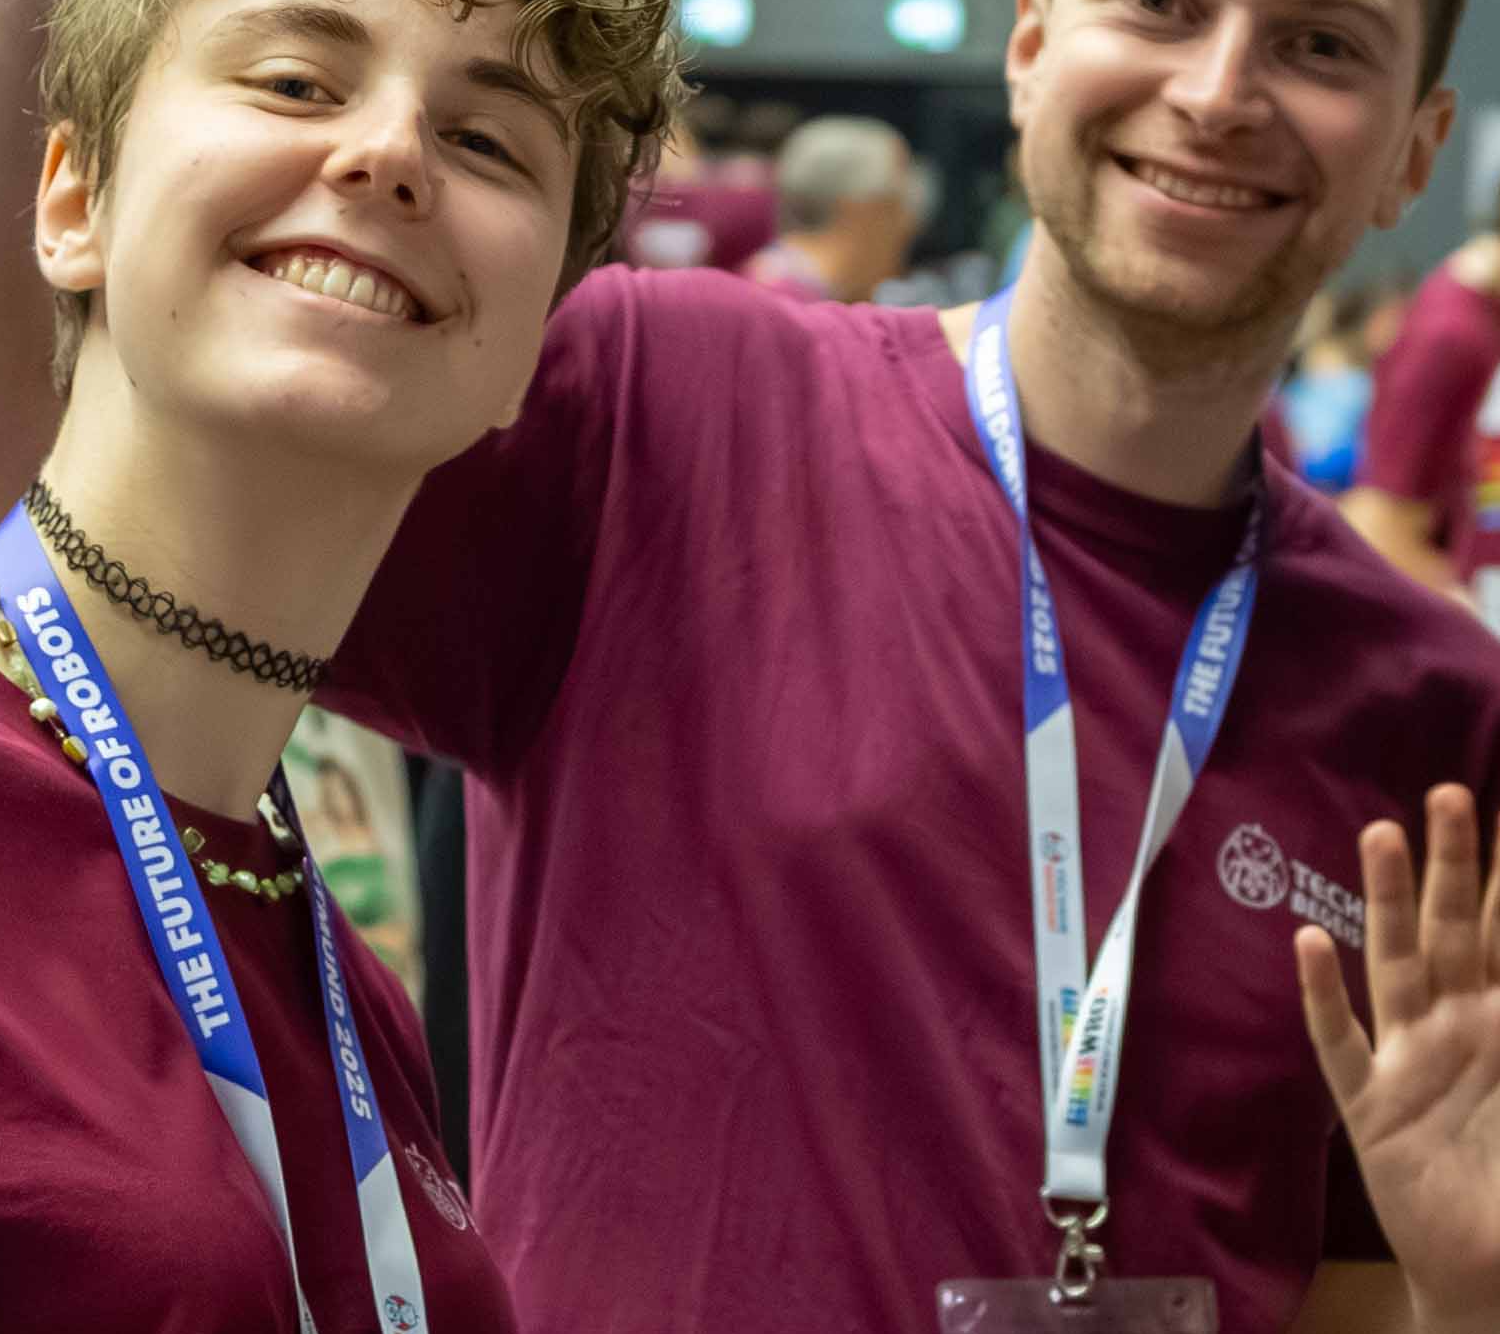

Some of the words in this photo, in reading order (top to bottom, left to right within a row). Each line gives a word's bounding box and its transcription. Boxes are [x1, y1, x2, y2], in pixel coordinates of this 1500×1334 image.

[16, 585, 119, 736] ROBOTS
[1183, 660, 1223, 717] THE
[95, 735, 143, 791] OF
[120, 794, 204, 953] FUTURE
[1290, 858, 1365, 921] TECH
[176, 951, 231, 1040] THE
[334, 1024, 372, 1121] 2025
